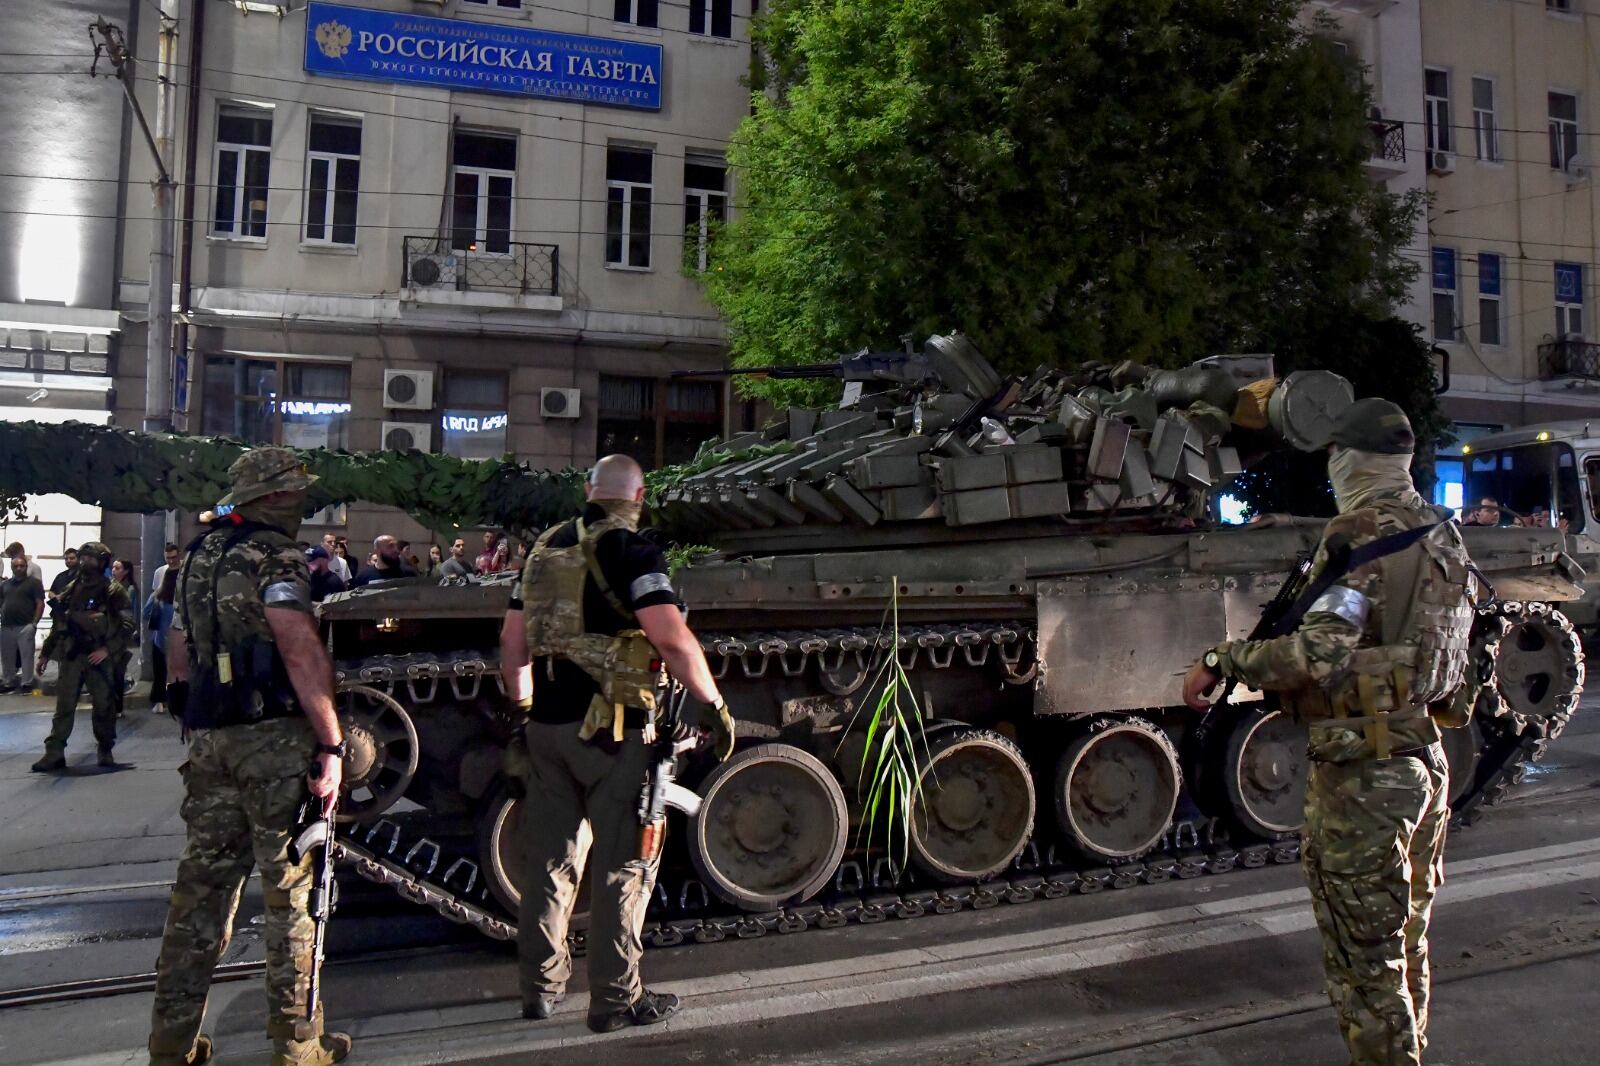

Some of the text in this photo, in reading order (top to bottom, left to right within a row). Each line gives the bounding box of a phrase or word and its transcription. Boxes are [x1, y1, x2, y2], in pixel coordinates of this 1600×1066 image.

[357, 30, 657, 85] РОССИЙСКАЯ ГАЗЕТА
[372, 61, 414, 73] ЮЖНОЕ
[421, 67, 515, 84] РЕГИОНАЛЬНОЕ
[522, 78, 649, 99] ПРЕДСТАВИТЕЛЬСТВО
